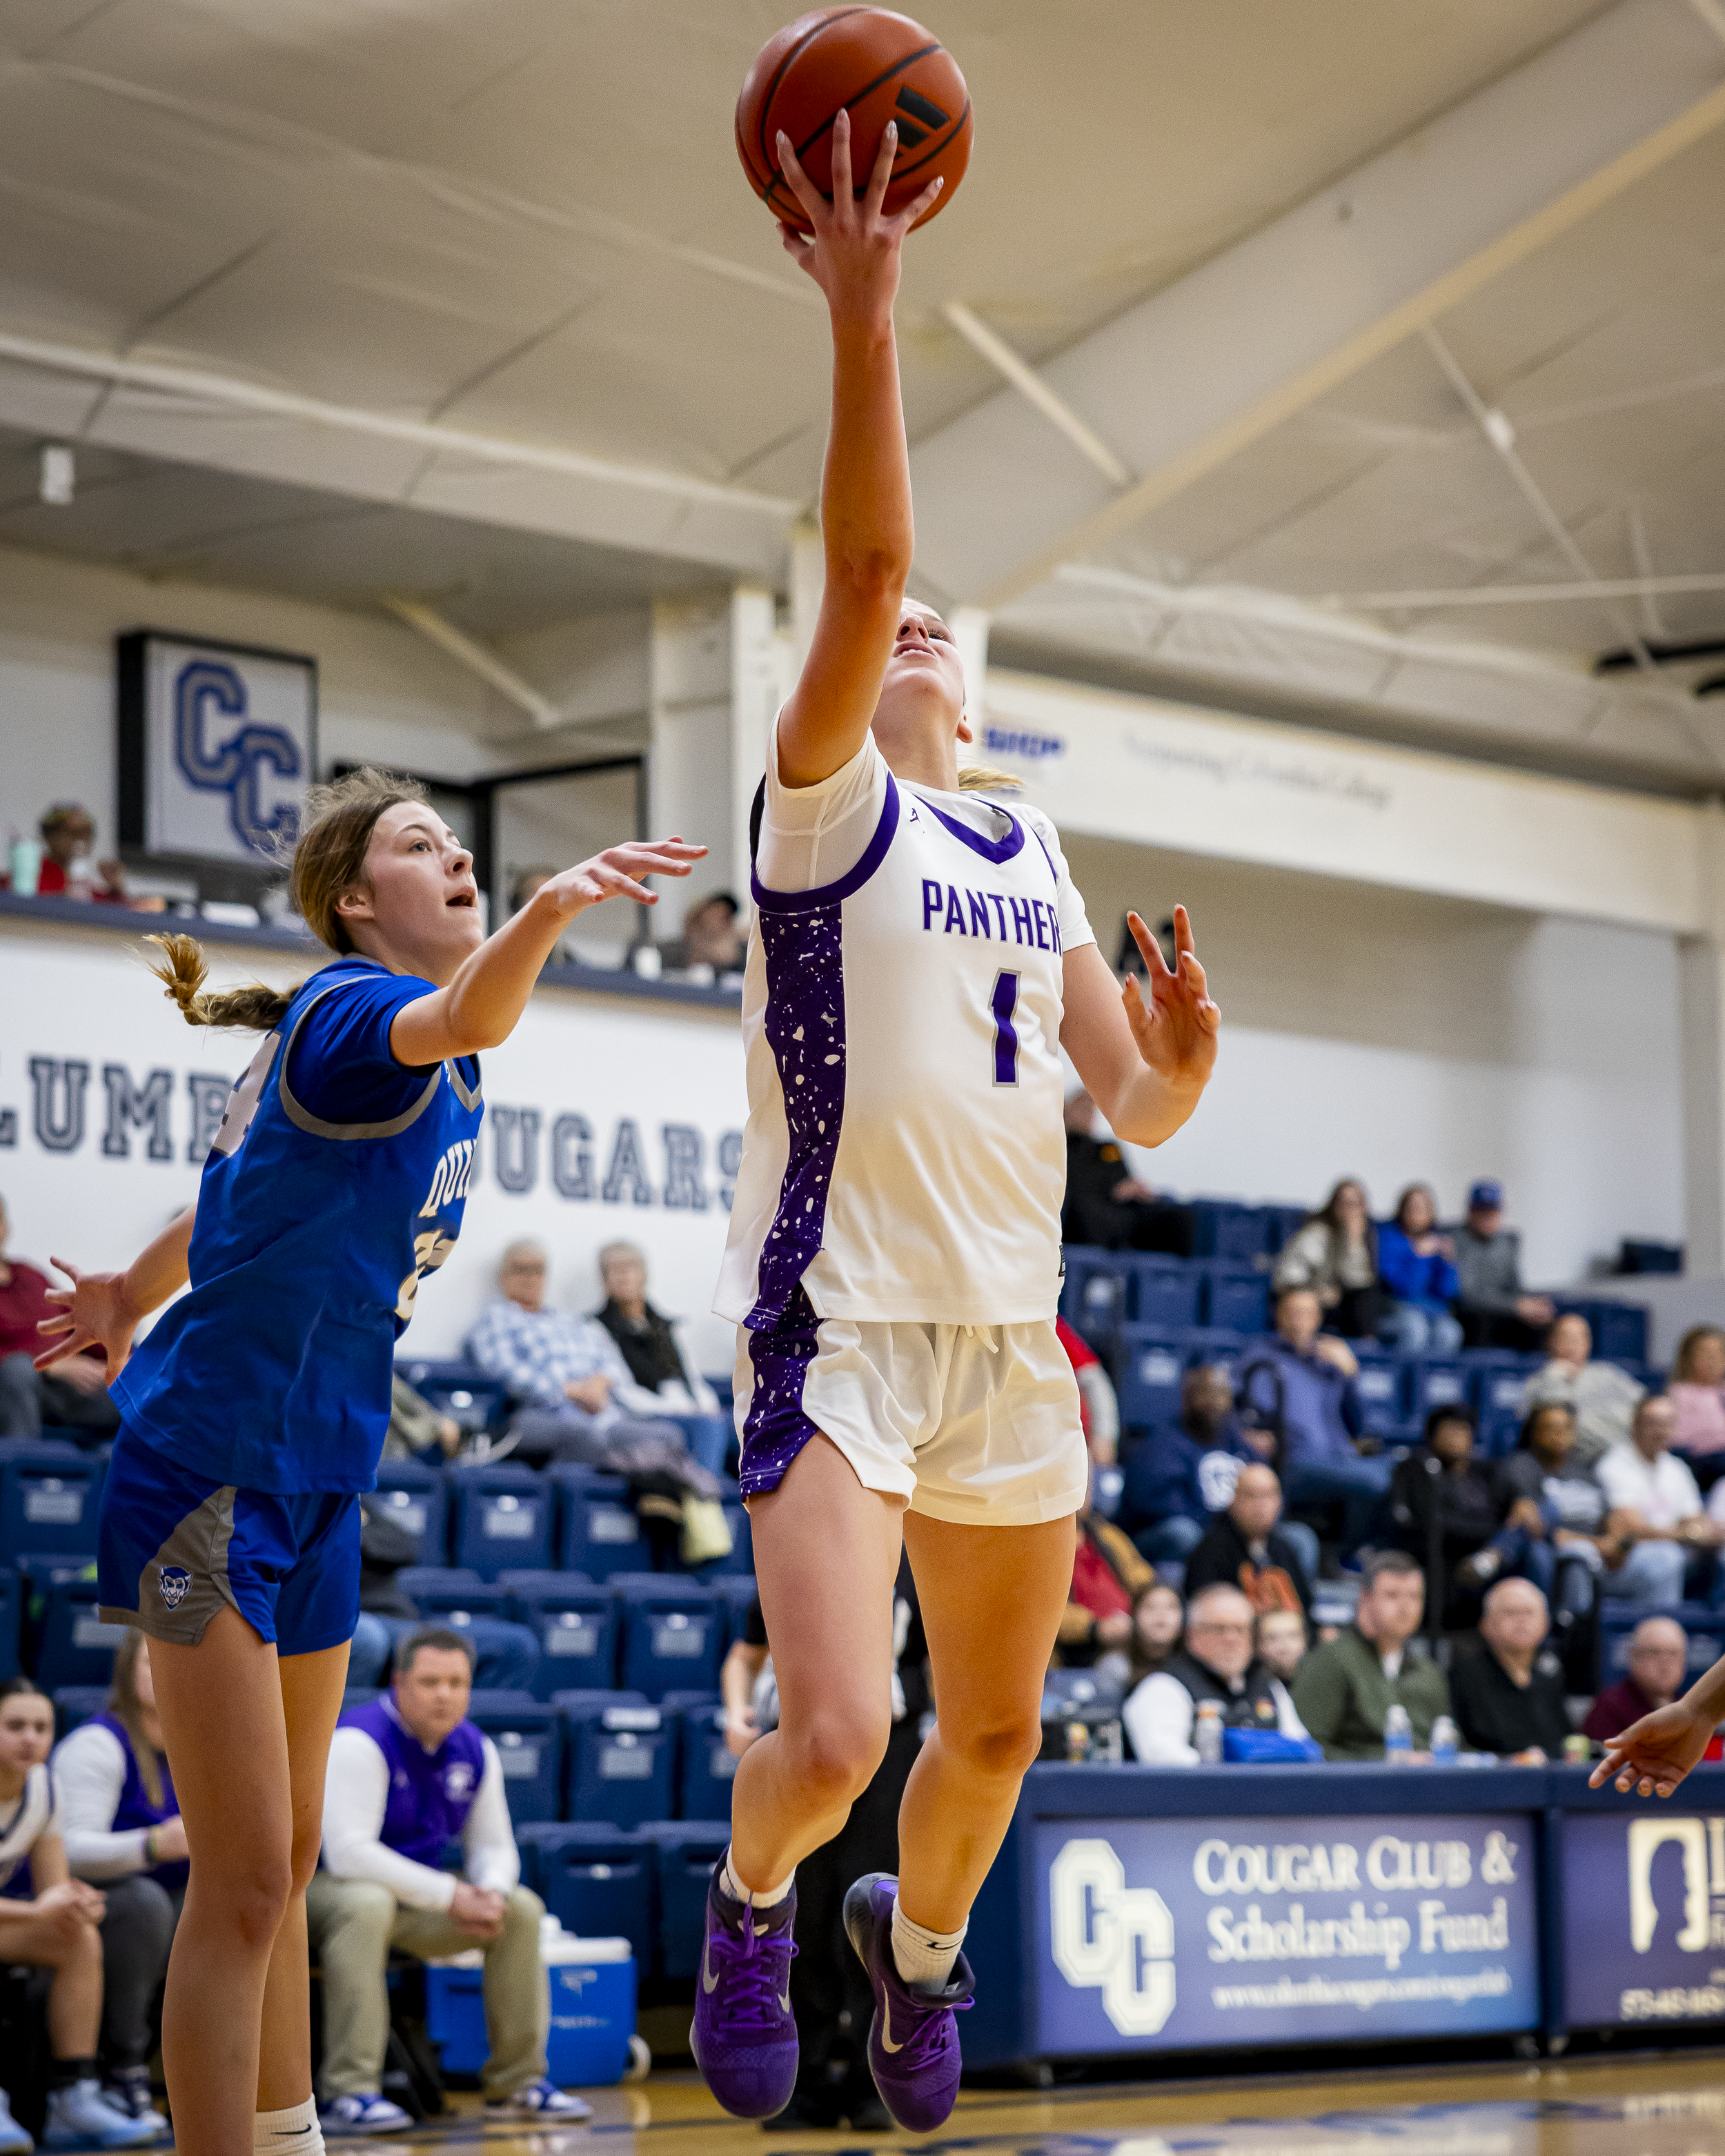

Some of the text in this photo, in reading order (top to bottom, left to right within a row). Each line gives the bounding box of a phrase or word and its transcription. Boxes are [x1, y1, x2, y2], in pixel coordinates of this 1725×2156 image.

[175, 661, 300, 854] CC
[987, 967, 1022, 1088] 1
[1193, 1838, 1362, 1896] COUGAR
[1481, 1830, 1518, 1886] &
[1049, 1838, 1176, 2037] CC
[1207, 1896, 1509, 1970] Scholarship Fund
